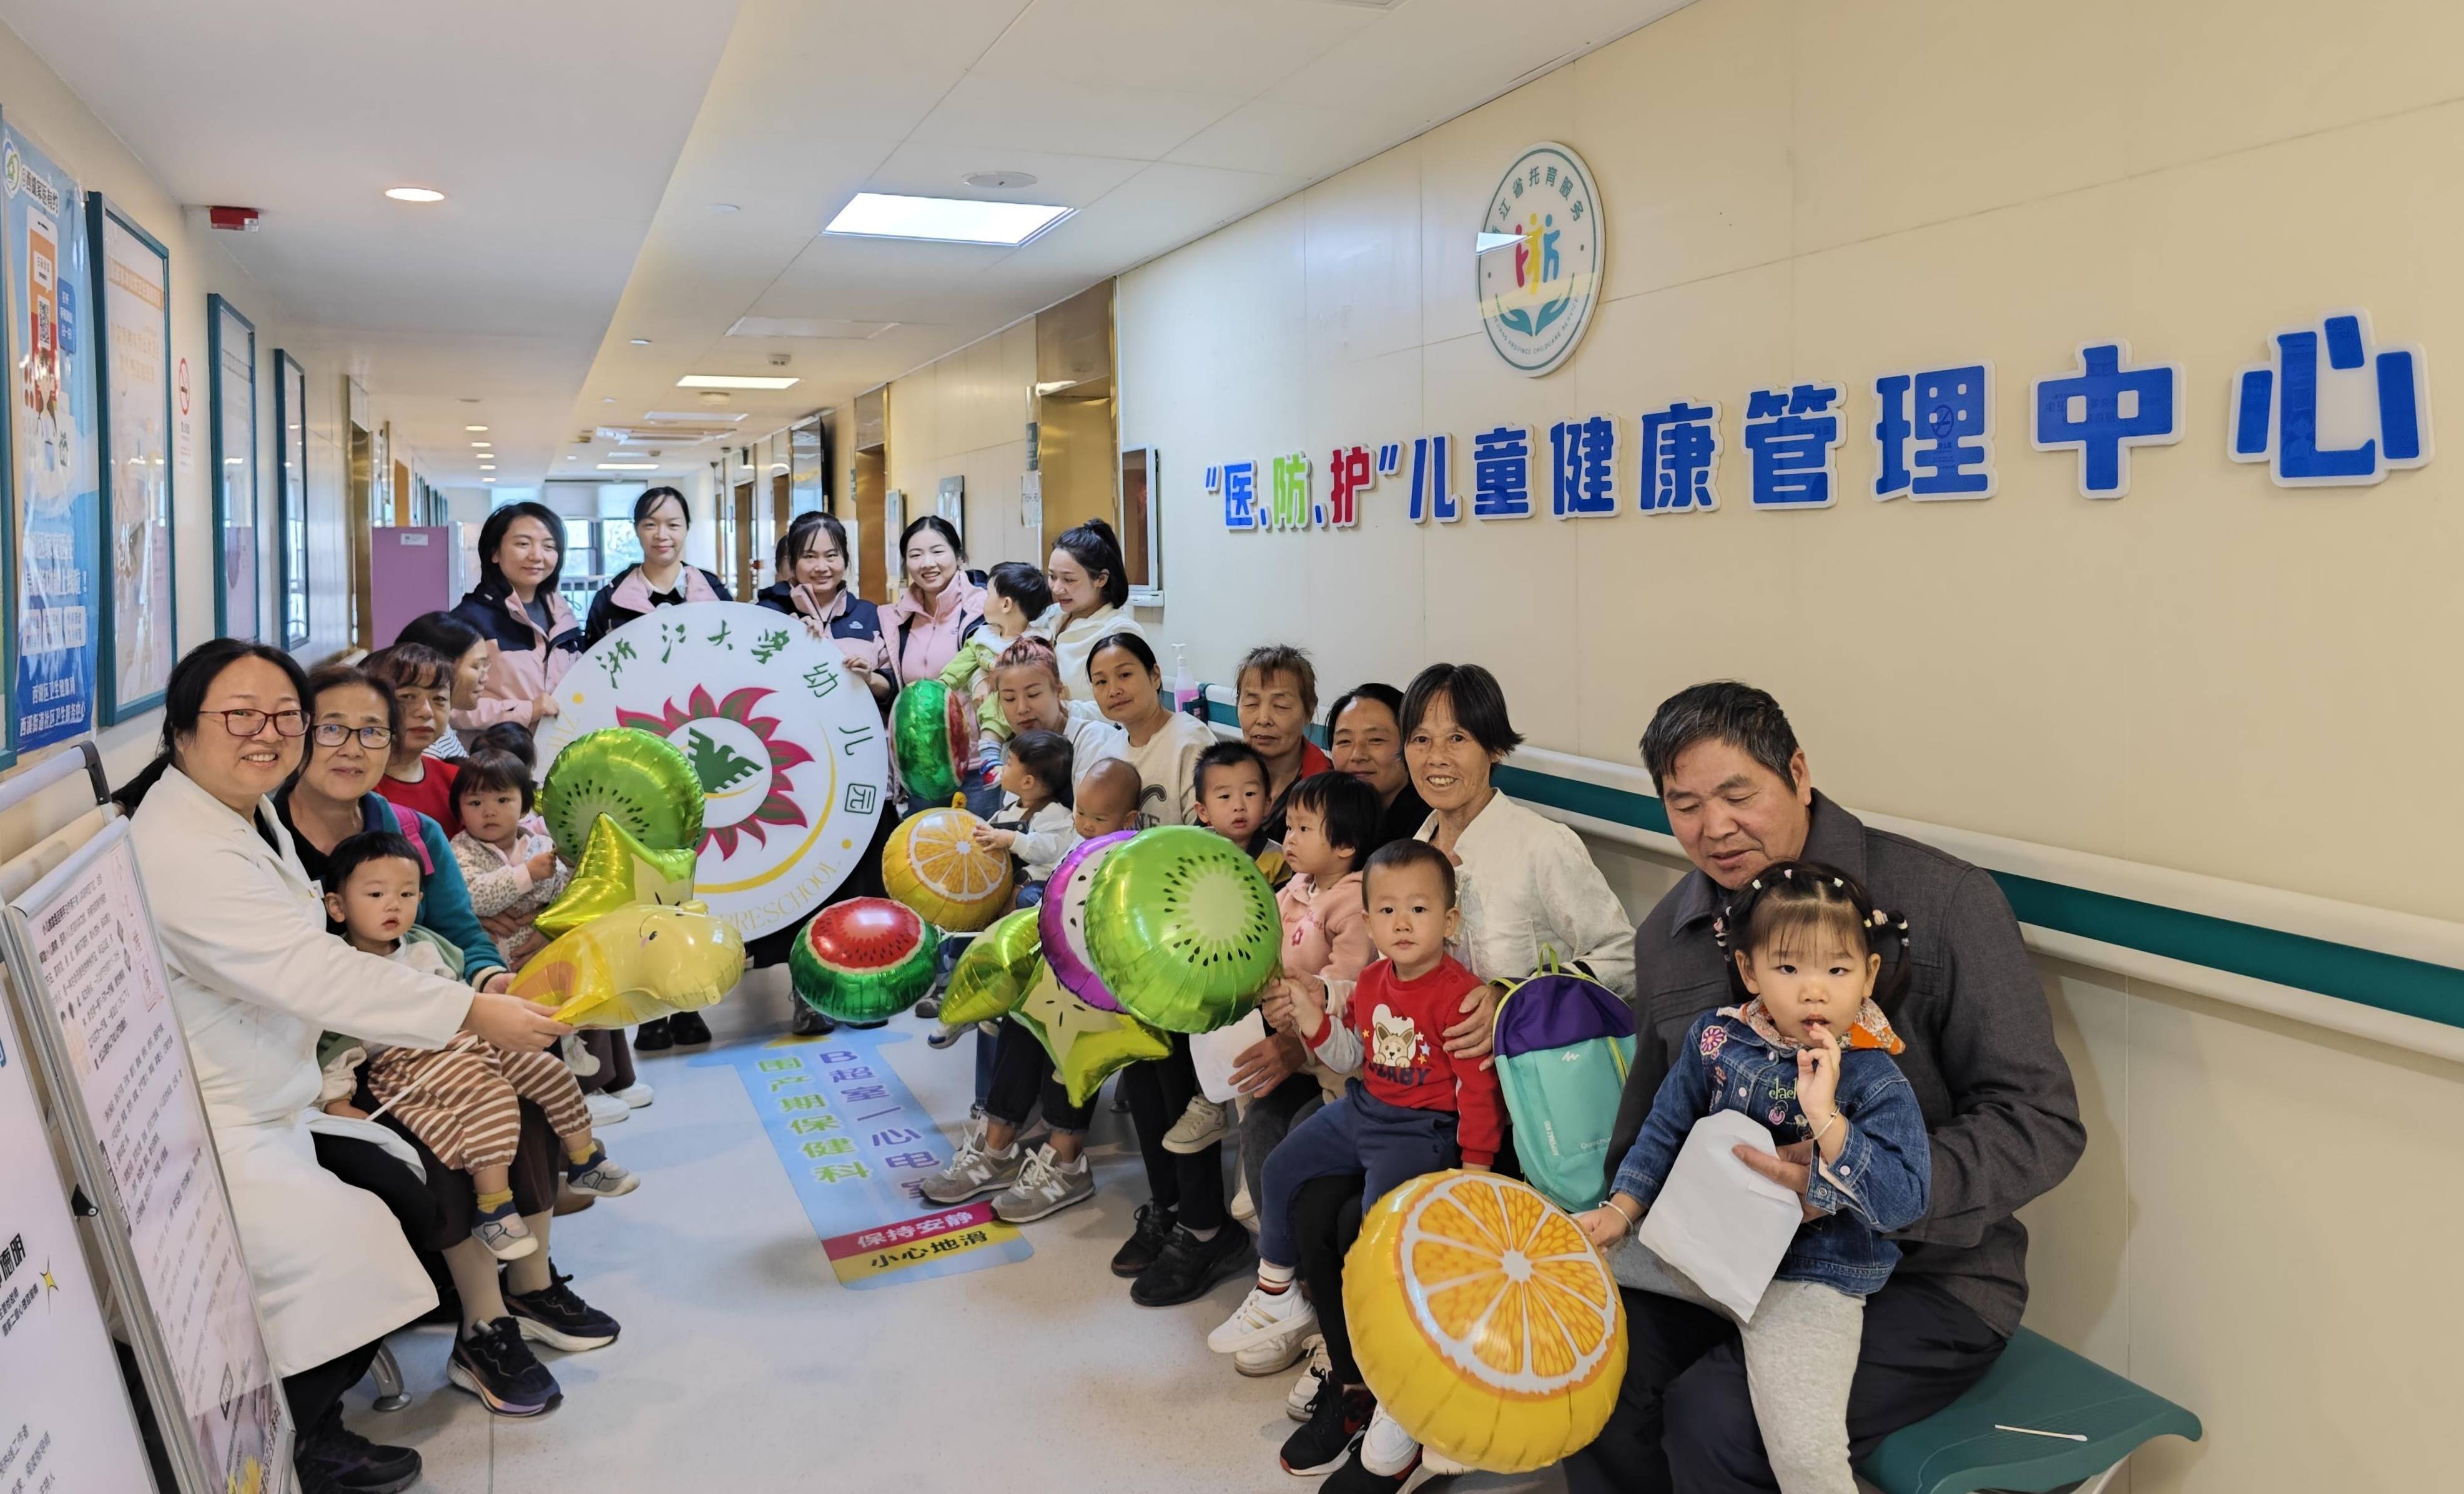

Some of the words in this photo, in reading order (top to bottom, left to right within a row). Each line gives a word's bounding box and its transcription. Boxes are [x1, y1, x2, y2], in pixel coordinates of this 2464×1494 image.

[857, 1211, 974, 1249] 保持安静
[870, 1230, 988, 1269] 小心地滑
[0, 1232, 26, 1289] 德明
